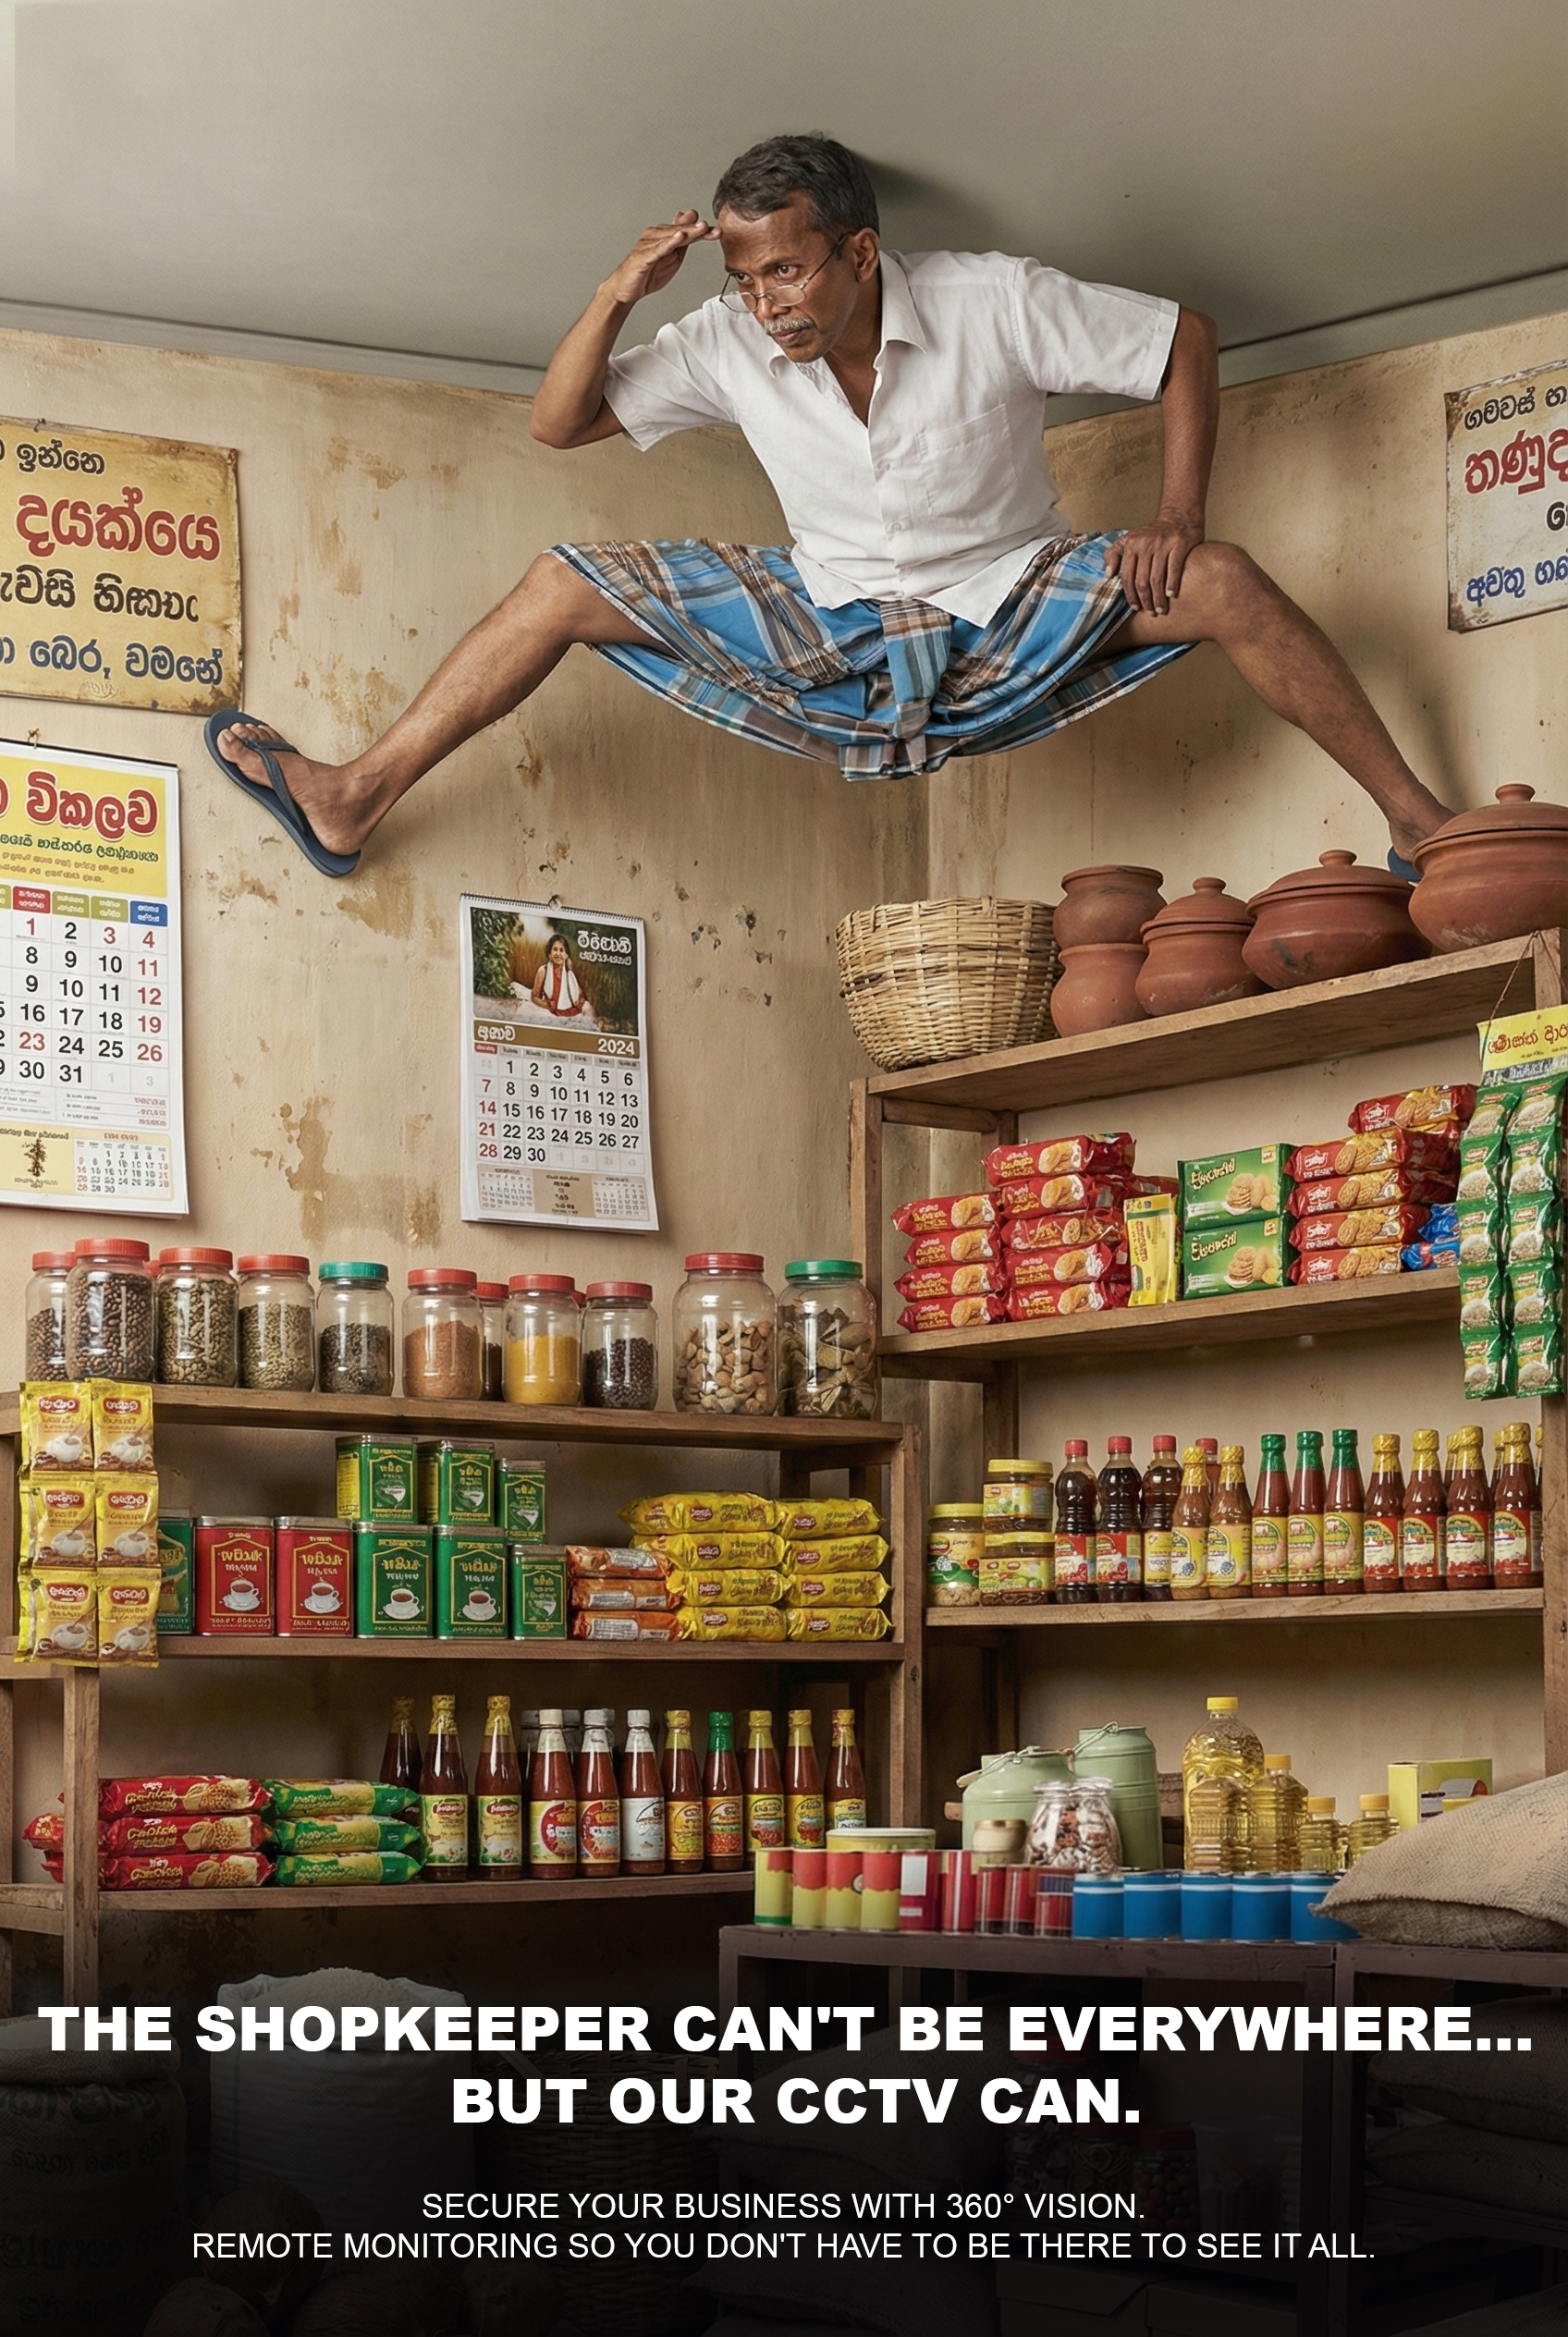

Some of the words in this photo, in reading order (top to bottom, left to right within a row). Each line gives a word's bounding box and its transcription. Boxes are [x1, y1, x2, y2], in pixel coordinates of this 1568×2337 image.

[27, 918, 34, 936] 1
[65, 922, 77, 939] 2
[104, 927, 116, 944] 3
[142, 931, 154, 948] 4
[26, 947, 38, 963] 8
[65, 951, 77, 968] 9
[99, 955, 122, 973] 10
[138, 959, 157, 976] 11
[26, 975, 38, 992] 9
[59, 979, 83, 997] 10
[99, 984, 118, 1001] 11
[138, 987, 161, 1005] 12
[20, 1004, 44, 1022] 16
[59, 1008, 83, 1025] 17
[99, 1011, 122, 1030] 18
[138, 1016, 161, 1034] 19
[19, 1032, 44, 1050] 23
[59, 1036, 84, 1054] 24
[99, 1040, 123, 1058] 25
[138, 1044, 162, 1061] 26
[597, 1038, 635, 1055] 2024
[19, 1060, 44, 1079] 30
[59, 1065, 81, 1083] 31
[507, 1061, 512, 1073] 1
[530, 1063, 538, 1076] 2
[554, 1065, 562, 1079] 3
[577, 1069, 585, 1082] 4
[601, 1071, 609, 1083] 5
[624, 1072, 632, 1086] 6
[483, 1079, 491, 1092] 7
[507, 1082, 515, 1095] 8
[531, 1084, 539, 1097] 9
[550, 1086, 567, 1100] 10
[574, 1089, 589, 1103] 11
[598, 1092, 614, 1106] 12
[621, 1094, 638, 1107] 13
[480, 1101, 496, 1114] 14
[503, 1103, 521, 1117] 15
[527, 1106, 544, 1120] 16
[551, 1107, 568, 1121] 17
[575, 1110, 592, 1124] 18
[599, 1112, 615, 1126] 19
[621, 1114, 638, 1128] 20
[479, 1122, 495, 1136] 21
[503, 1124, 521, 1139] 22
[527, 1127, 545, 1141] 23
[552, 1129, 569, 1142] 24
[575, 1131, 593, 1144] 25
[599, 1133, 616, 1147] 26
[622, 1135, 639, 1148] 27
[480, 1144, 497, 1157] 28
[504, 1145, 521, 1160] 29
[528, 1148, 545, 1162] 30
